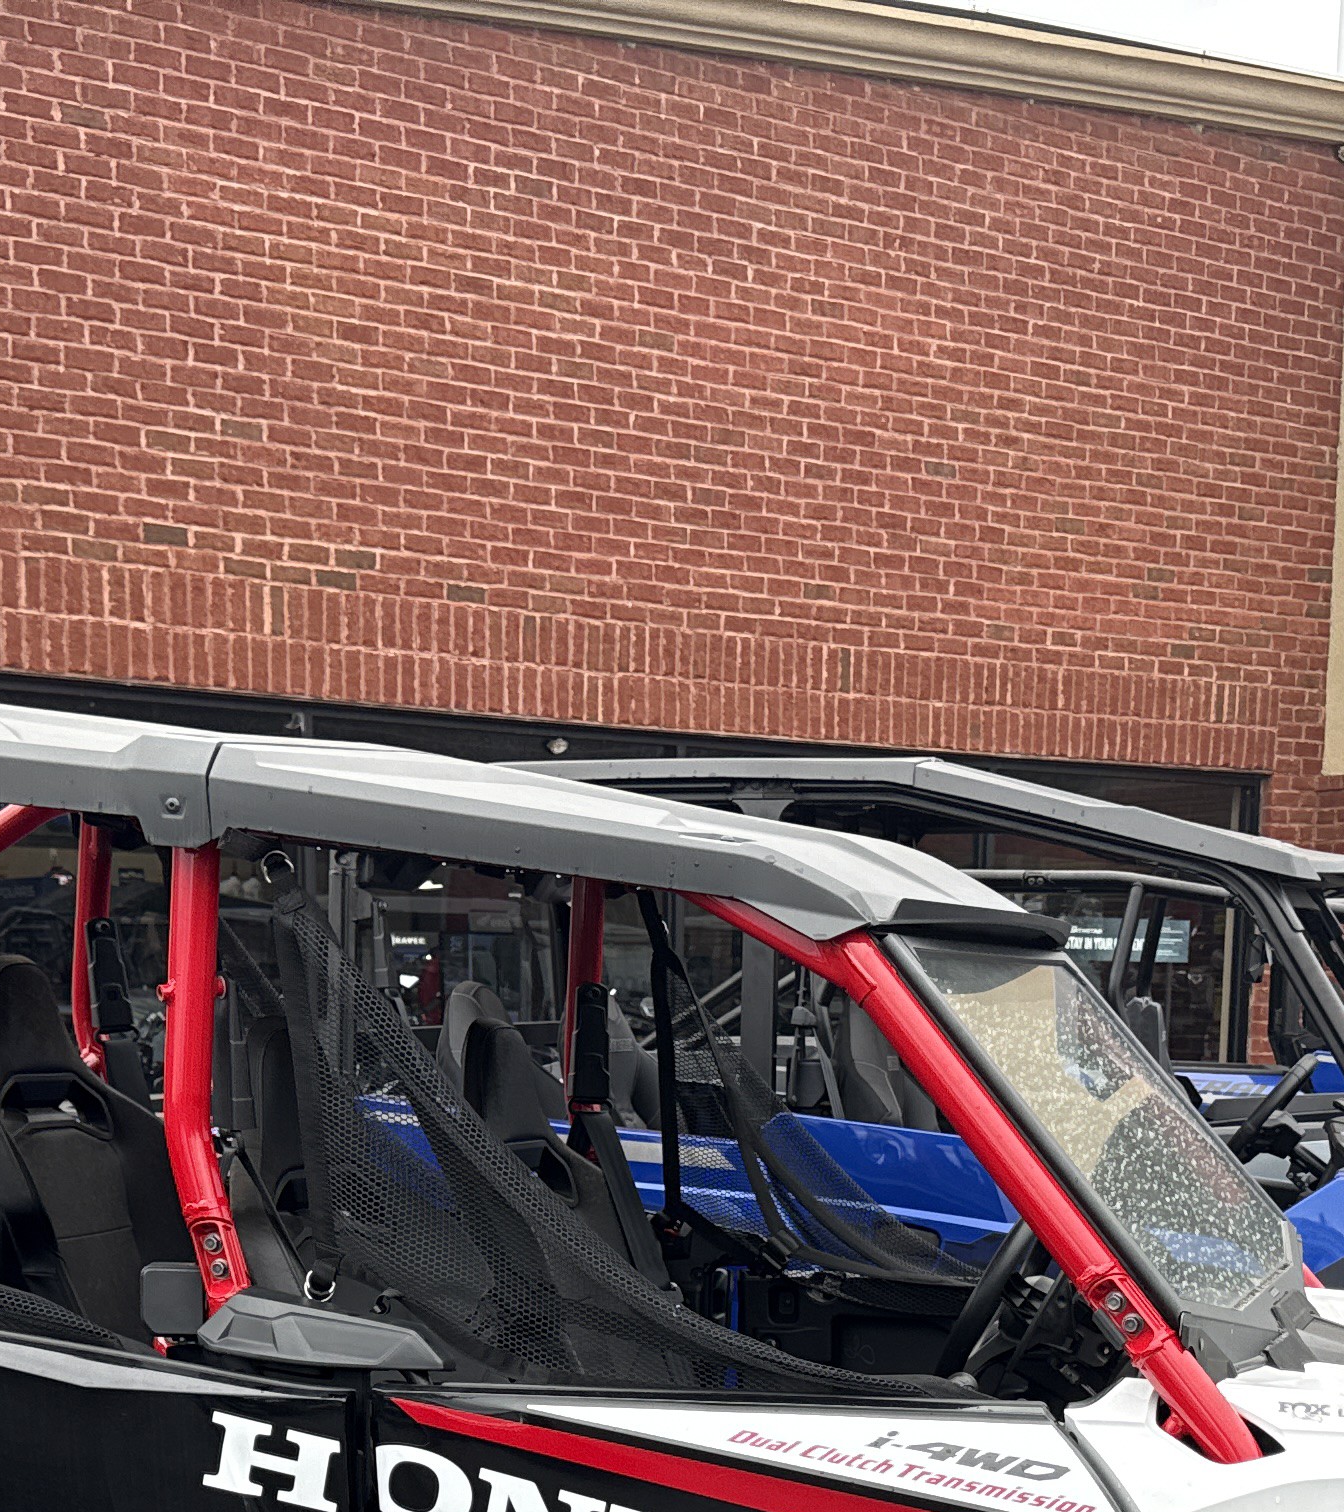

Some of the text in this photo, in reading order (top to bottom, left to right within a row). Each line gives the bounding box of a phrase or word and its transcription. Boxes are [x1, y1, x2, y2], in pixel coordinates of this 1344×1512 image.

[1277, 1400, 1332, 1424] FOX
[726, 1429, 801, 1454] Dual
[799, 1444, 896, 1476] Clutch
[866, 1430, 1072, 1481] i-4WD
